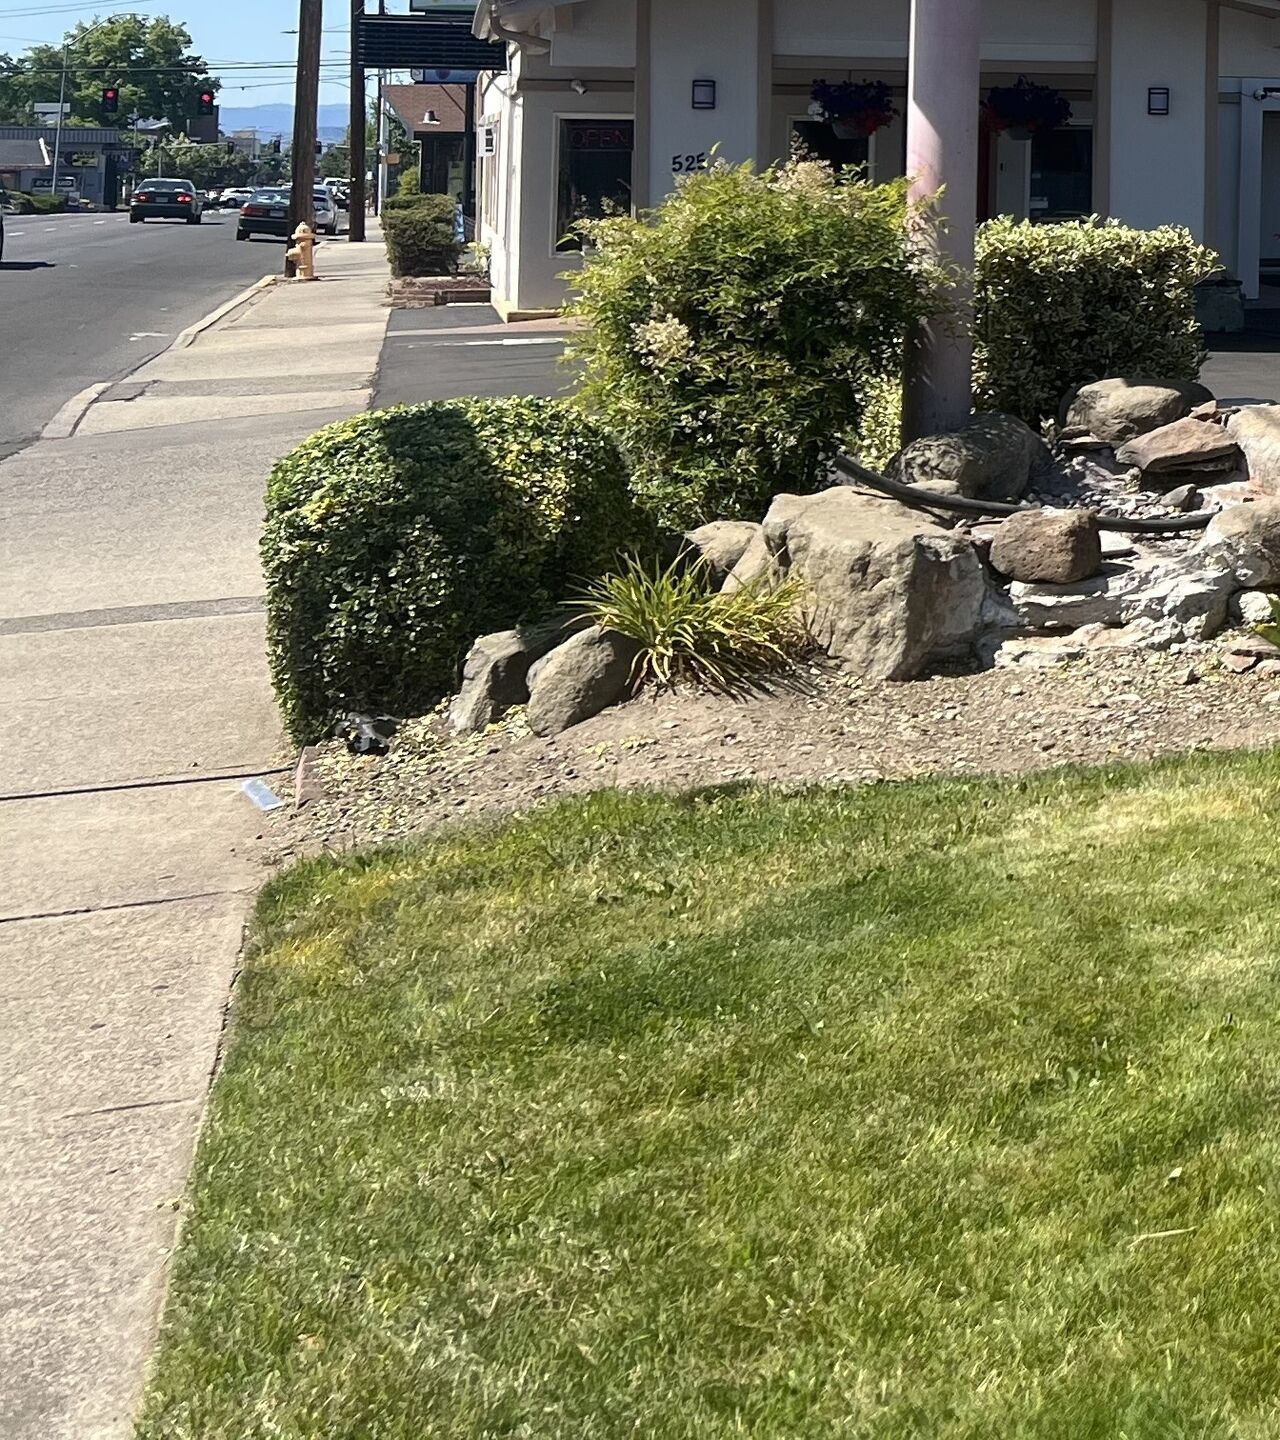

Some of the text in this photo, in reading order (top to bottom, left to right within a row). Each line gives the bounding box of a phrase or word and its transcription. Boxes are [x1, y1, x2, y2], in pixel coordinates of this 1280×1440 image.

[571, 128, 629, 148] OPEN
[671, 152, 707, 173] 525
[35, 179, 73, 187] E-LIUID
